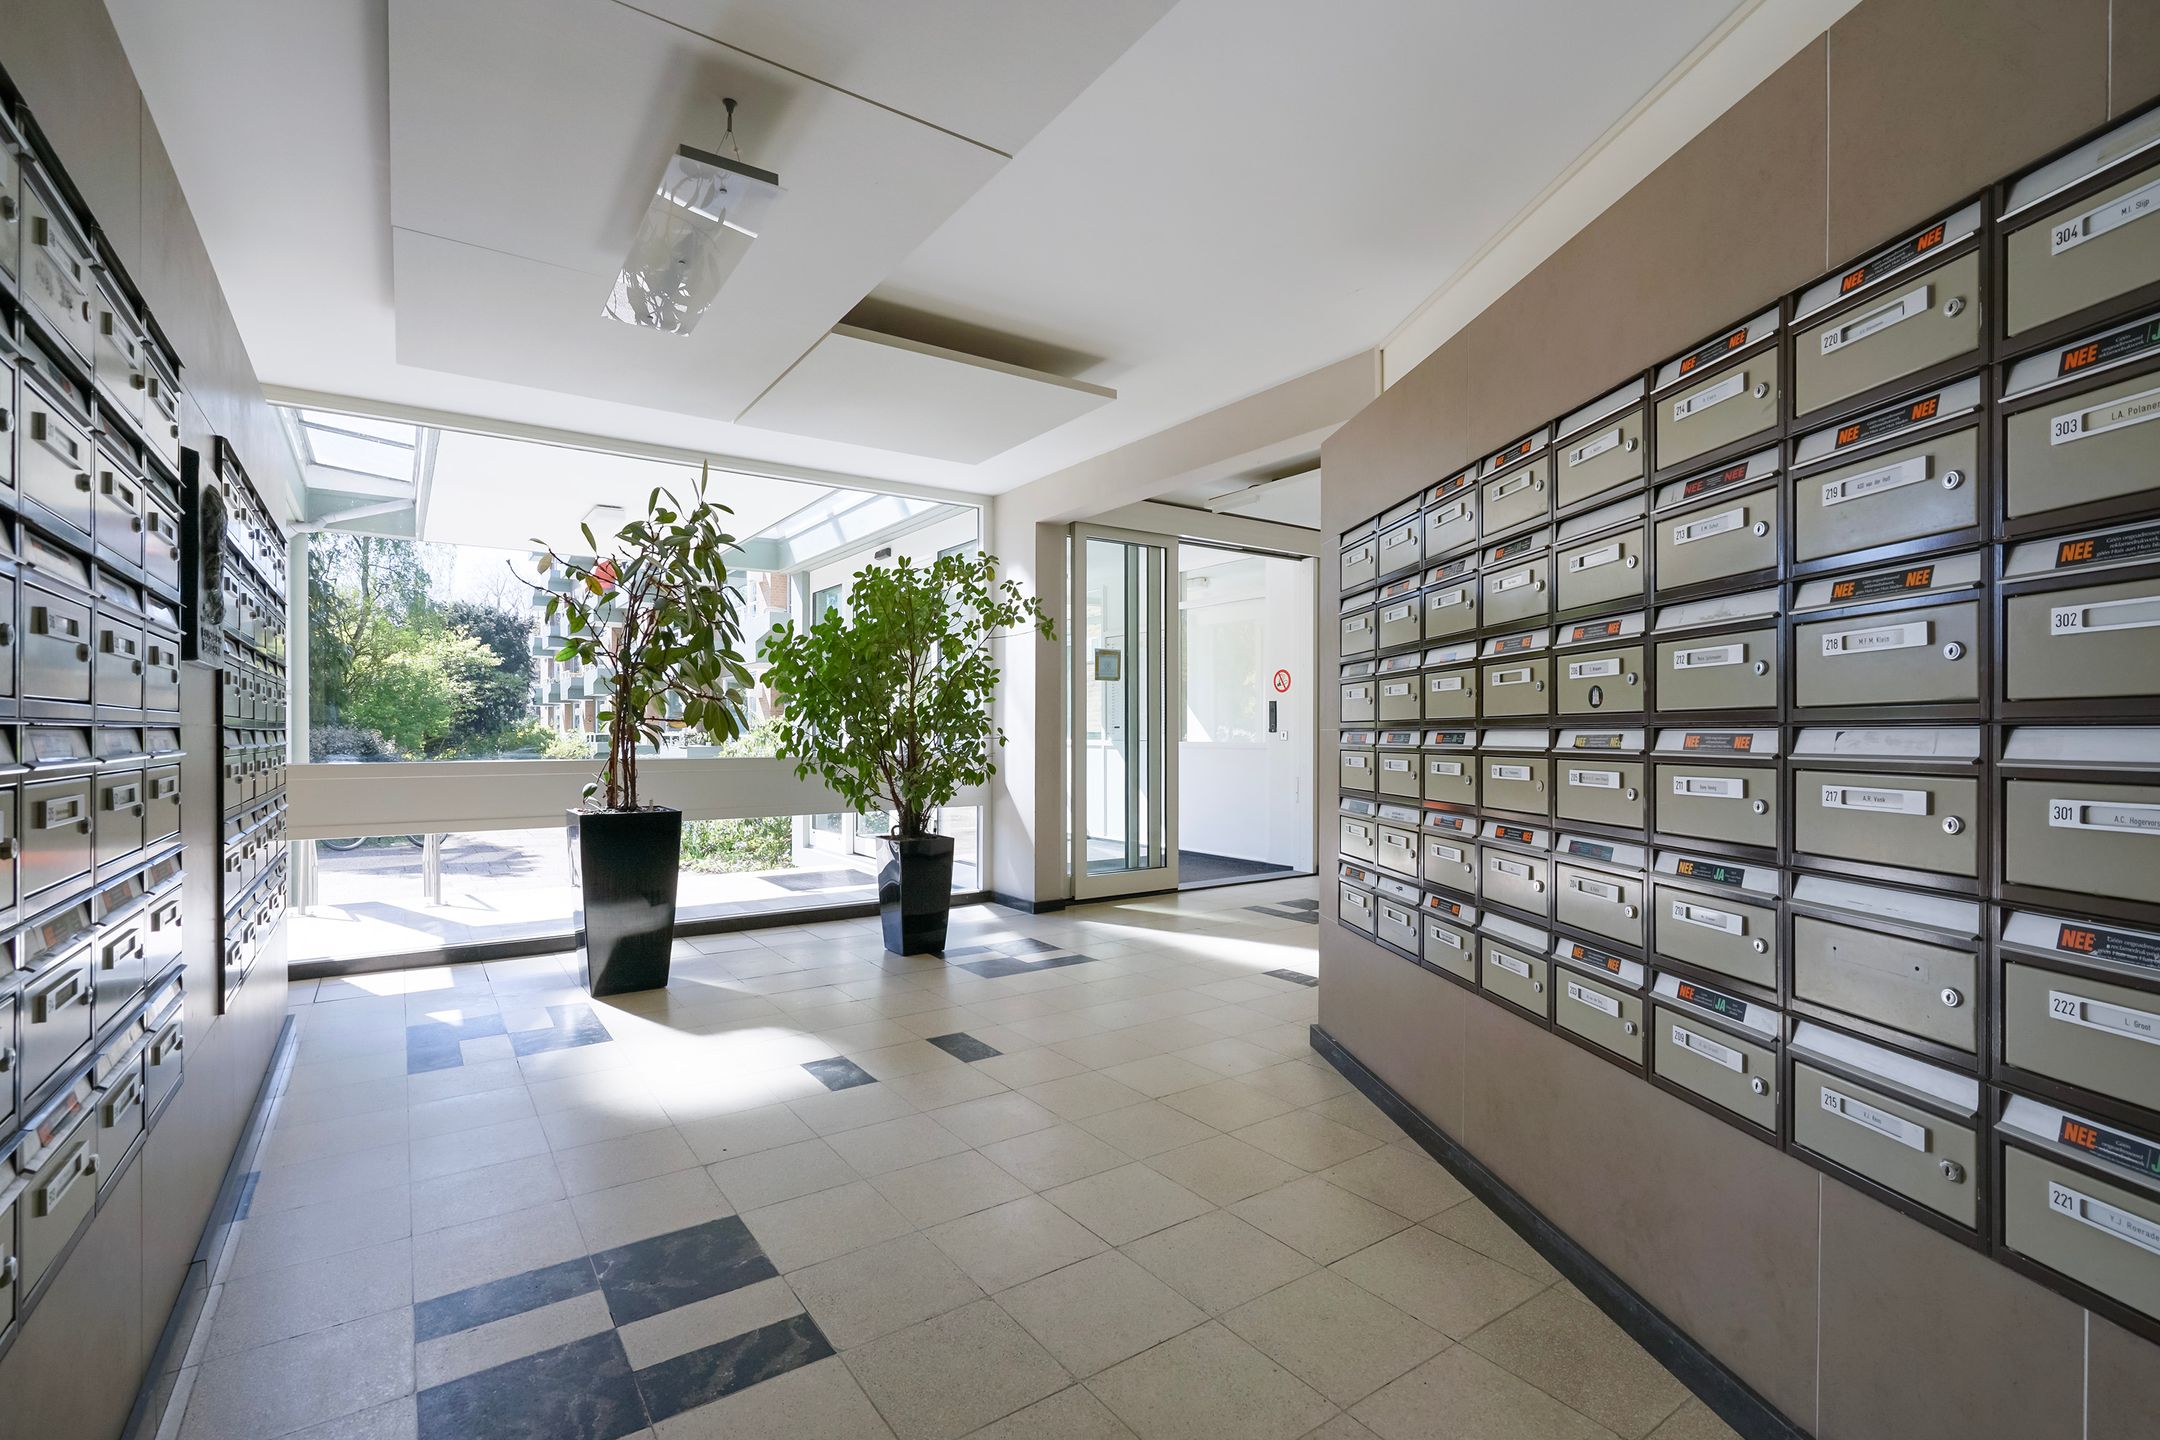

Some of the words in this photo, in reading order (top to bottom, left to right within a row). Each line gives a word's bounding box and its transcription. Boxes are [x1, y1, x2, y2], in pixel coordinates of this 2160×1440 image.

[1917, 225, 1944, 252] NEE
[2055, 224, 2078, 246] 304
[1842, 268, 1865, 292] NEE
[1823, 332, 1838, 349] 220
[2063, 343, 2099, 371] NEE
[1911, 398, 1937, 421] NEE
[1837, 424, 1860, 445] NEE
[2055, 418, 2078, 437] 303
[1723, 466, 1745, 482] NEE
[1825, 486, 1838, 501] 219
[2060, 539, 2095, 564] NEE
[1905, 568, 1931, 588] NEE
[1833, 581, 1856, 599] NEE
[2055, 611, 2078, 628] 302
[1825, 638, 1838, 651] 218
[1675, 654, 1685, 665] 212
[1733, 736, 1751, 750] NEE
[1825, 790, 1838, 802] 217
[2053, 805, 2073, 821] 301
[1678, 861, 1694, 875] NEE
[1713, 867, 1725, 881] JA
[2061, 928, 2096, 952] NEE
[1679, 984, 1696, 1000] NEE
[1714, 997, 1726, 1012] JA
[2053, 998, 2076, 1017] 222
[1824, 1093, 1837, 1109] 215
[2063, 1121, 2098, 1150] NEE
[2053, 1190, 2073, 1210] 221
